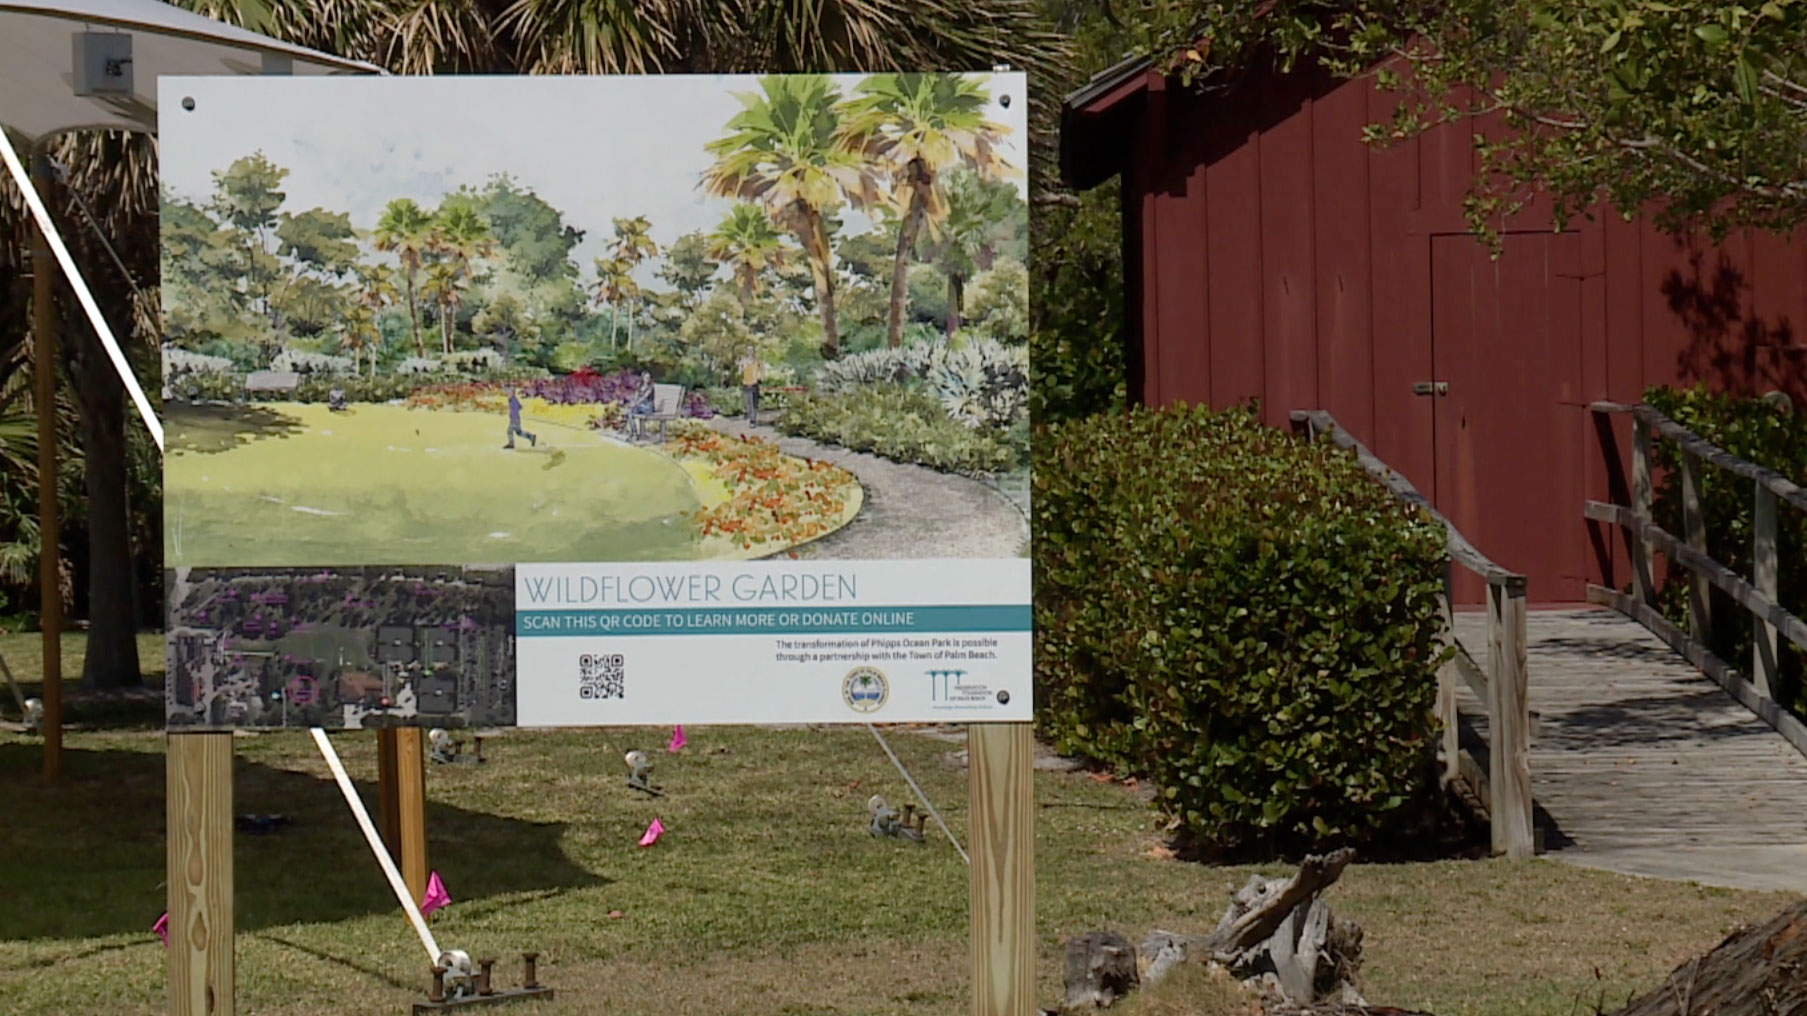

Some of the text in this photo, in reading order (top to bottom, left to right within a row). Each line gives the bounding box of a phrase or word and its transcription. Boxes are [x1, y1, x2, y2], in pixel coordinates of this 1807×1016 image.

[524, 574, 857, 603] WILDFLOWER GARDEN
[523, 611, 915, 631] SCAN THIS QR CODE TO LEARN MORE OR DONATE ONLINE
[776, 637, 998, 650] The transformation of Phipps Ocean Park is possible
[776, 653, 811, 662] through
[819, 652, 870, 662] partnership
[871, 651, 891, 660] with
[892, 651, 908, 660] the
[909, 651, 932, 659] Town
[934, 650, 943, 659] of
[944, 650, 967, 659] Palm
[968, 649, 998, 659] Beach.
